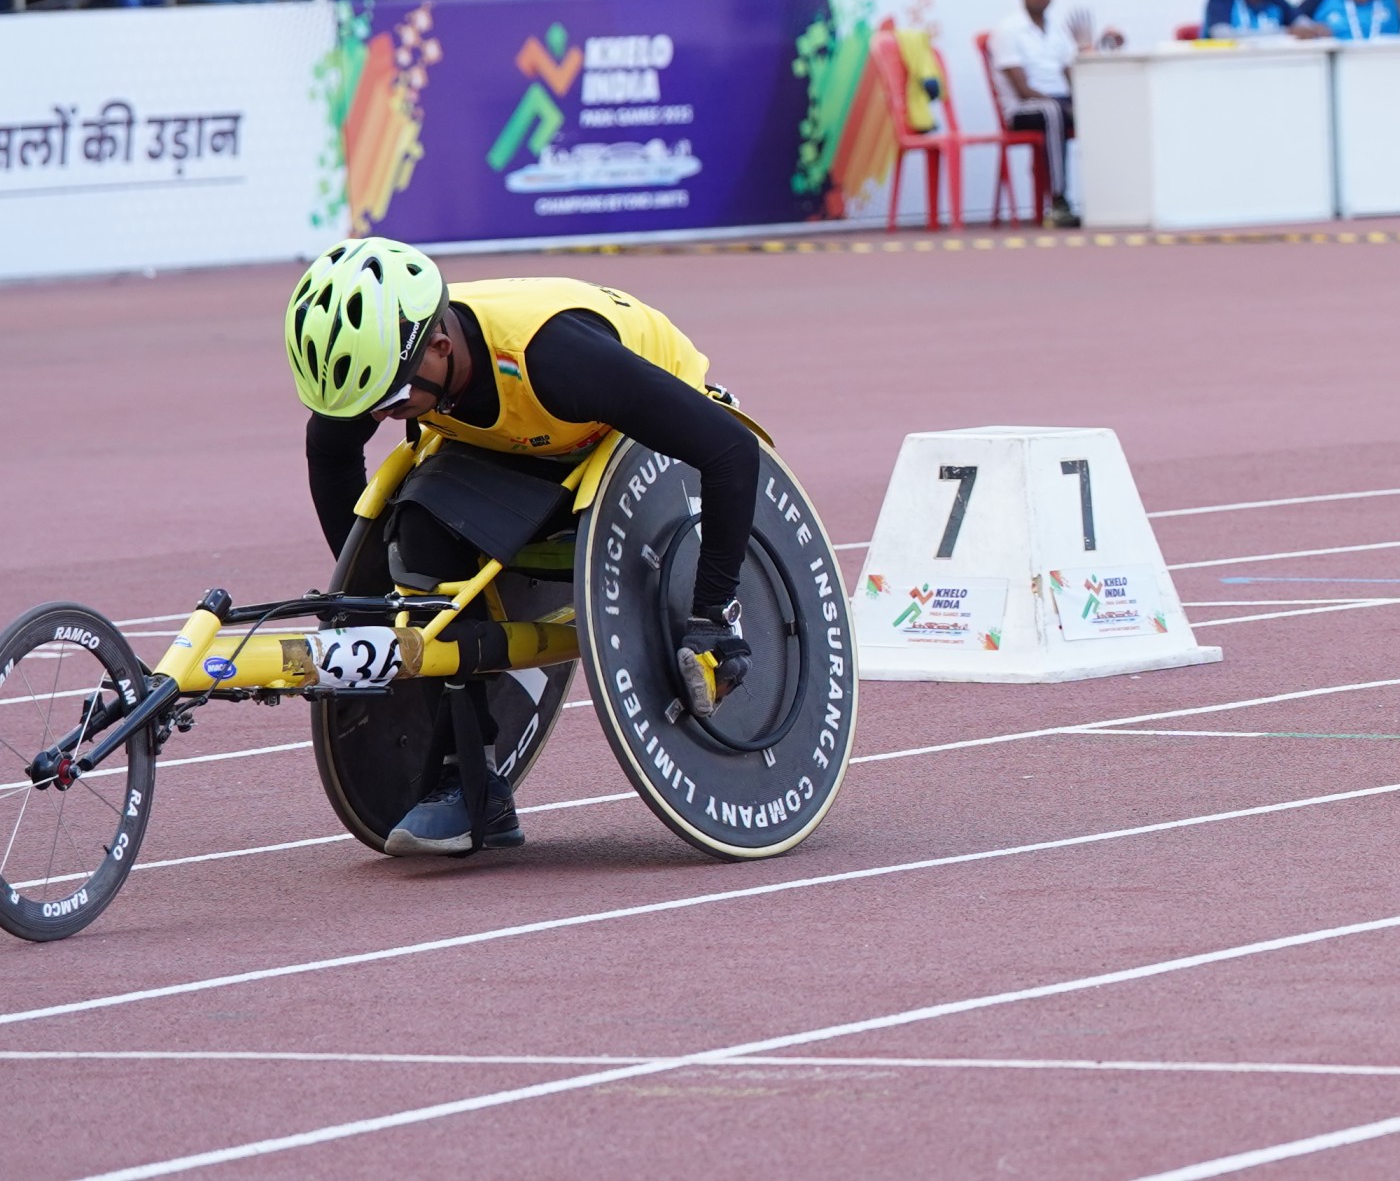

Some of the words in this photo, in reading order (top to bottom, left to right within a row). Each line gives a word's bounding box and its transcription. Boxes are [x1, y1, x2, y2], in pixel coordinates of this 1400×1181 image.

[584, 34, 673, 70] KHELO
[581, 69, 660, 106] INDIA
[82, 100, 134, 163] की
[147, 115, 242, 175] उड़ान
[406, 320, 420, 350] airava
[765, 476, 813, 547] LIFE
[936, 465, 978, 559] 7
[935, 588, 968, 599] KHELO
[1104, 577, 1128, 587] KHELO
[1105, 588, 1126, 598] INDIA
[932, 599, 960, 609] INDIA
[54, 626, 100, 650] RAMCO
[809, 558, 846, 770] INSURANCE
[615, 668, 697, 805] LIMITED
[705, 775, 814, 829] COMPANY
[43, 889, 88, 918] RAMCO
